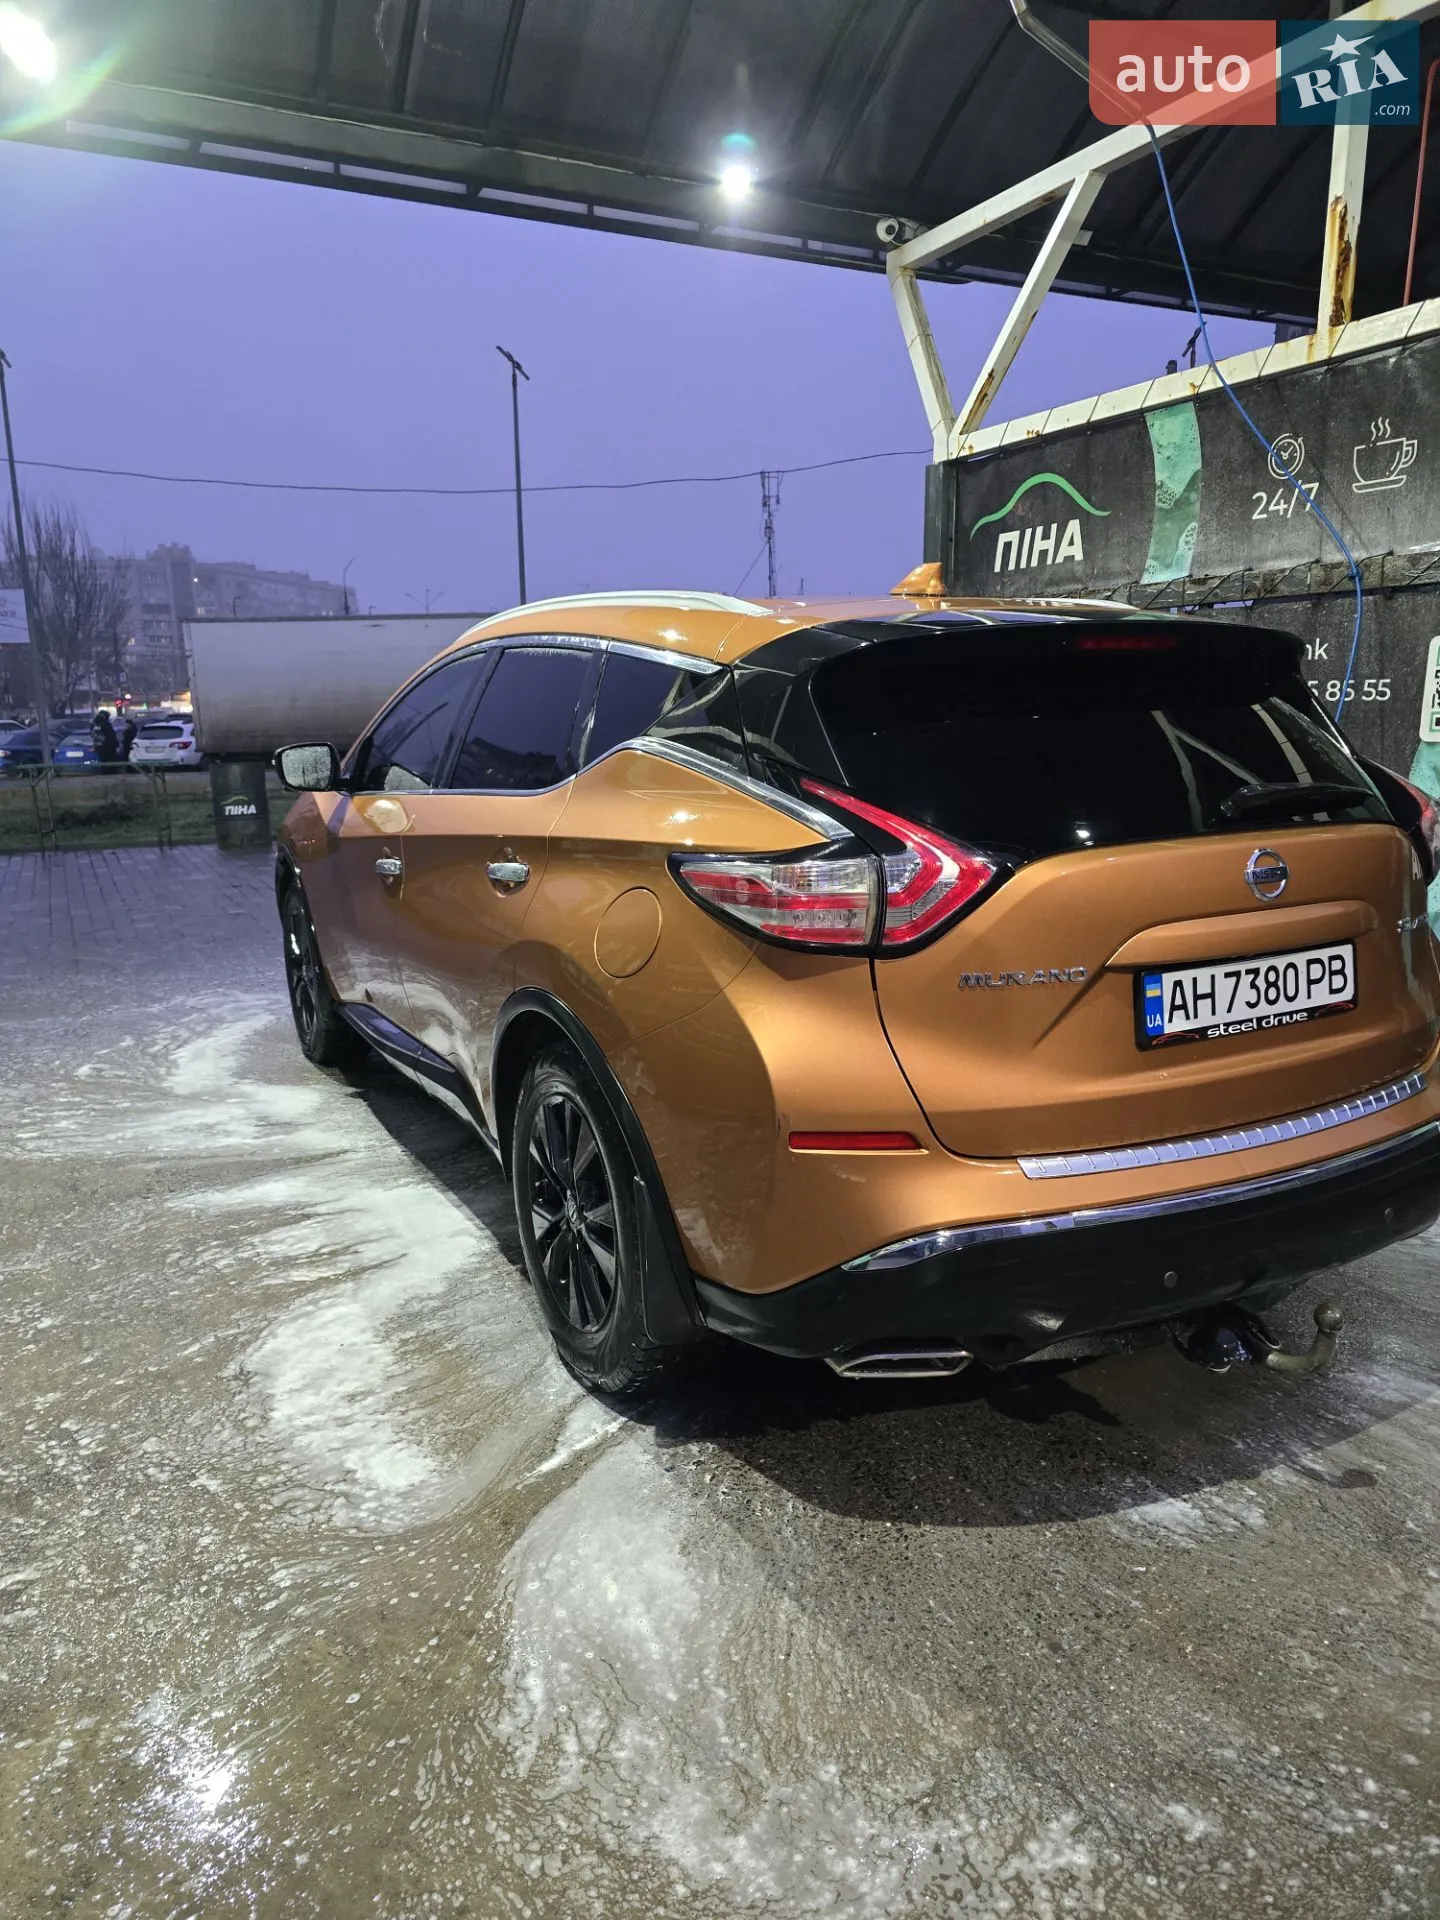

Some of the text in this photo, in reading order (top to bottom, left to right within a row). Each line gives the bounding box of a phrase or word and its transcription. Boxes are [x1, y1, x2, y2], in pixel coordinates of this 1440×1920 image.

[1251, 479, 1320, 520] 24/7
[993, 518, 1084, 573] ПІНА
[1361, 678, 1391, 701] 55
[958, 965, 1088, 989] MURANO
[1146, 1013, 1163, 1028] UA
[1207, 1011, 1308, 1038] steel drive
